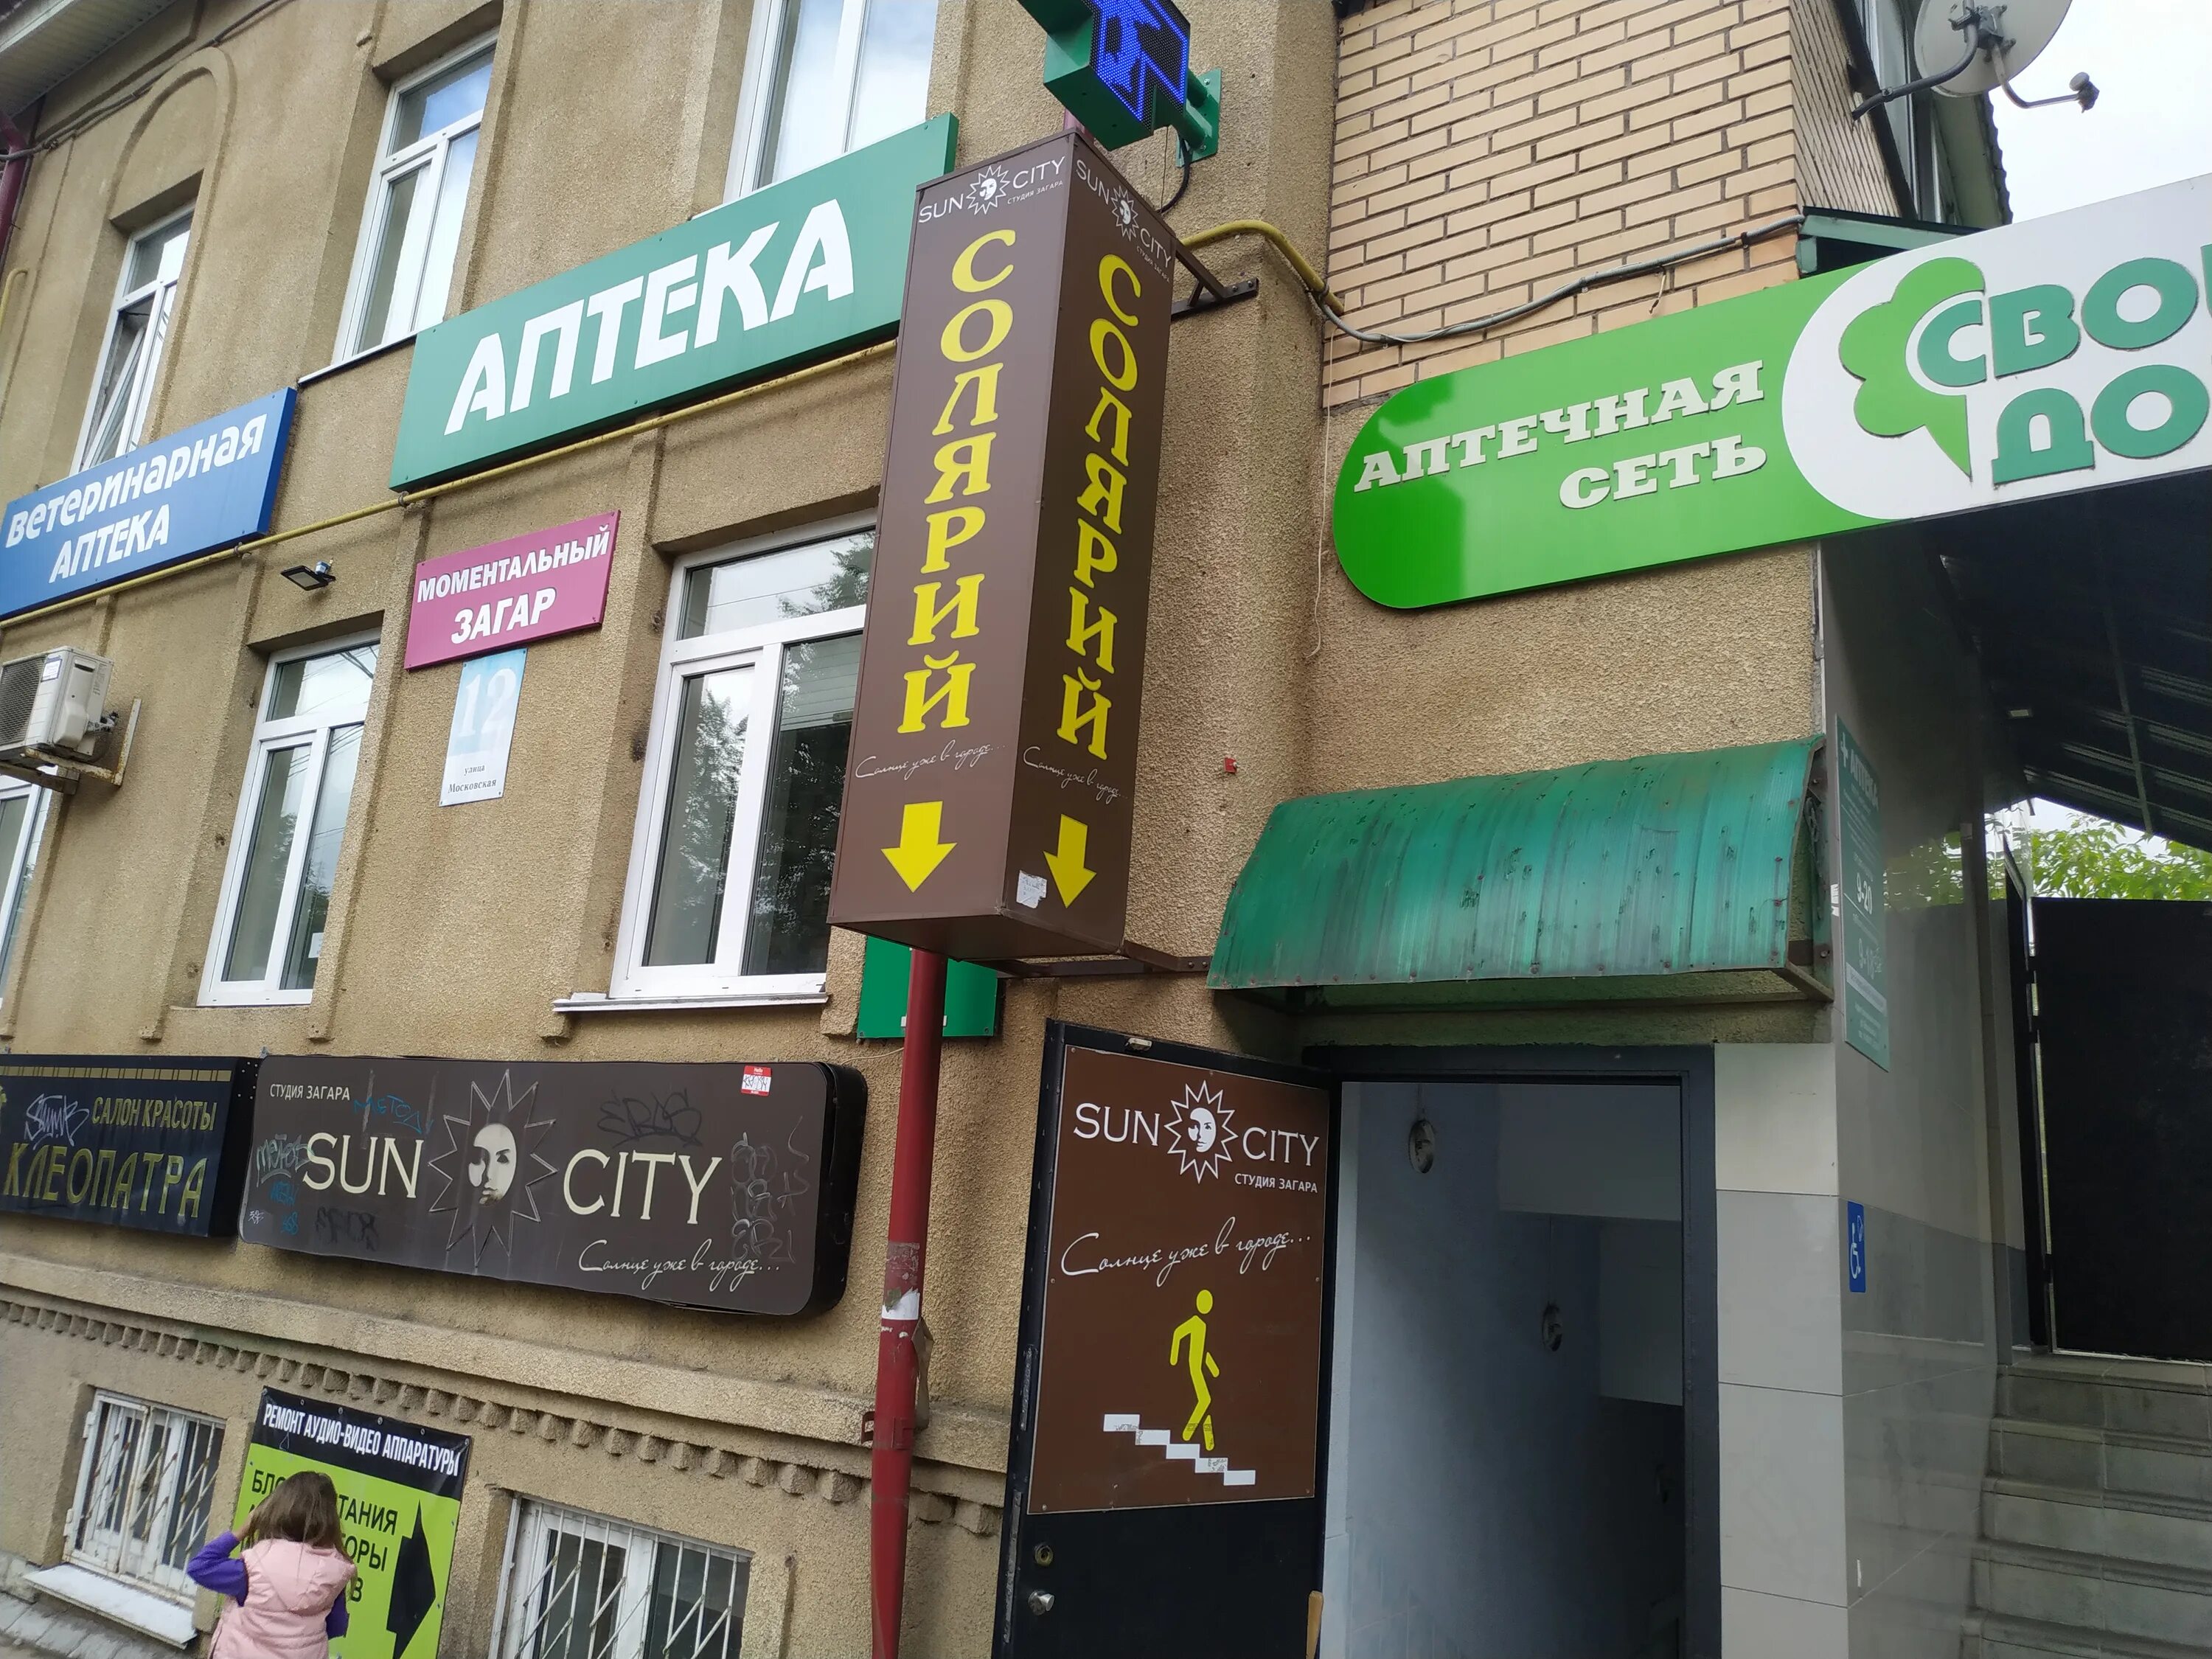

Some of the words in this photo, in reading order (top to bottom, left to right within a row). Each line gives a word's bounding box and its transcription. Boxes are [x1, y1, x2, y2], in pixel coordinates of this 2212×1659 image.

[919, 193, 964, 223] SUN
[1012, 156, 1066, 189] CITY
[1007, 190, 1034, 205] СТУДИЯ
[1036, 180, 1064, 195] ЗАГАРА
[1076, 159, 1110, 205] SUN
[1140, 228, 1172, 268] CITY
[444, 198, 854, 436] АПТЕКА
[1917, 243, 2212, 387] СВО
[1354, 360, 1764, 493] АПТЕЧНАЯ
[1992, 364, 2211, 486] ДО
[897, 229, 1016, 734] СОЛЯРИЙ
[1559, 434, 1767, 509] СЕТЬ
[1057, 254, 1141, 760] СОЛЯРИЙ
[48, 504, 170, 584] АПТЕКА
[417, 524, 611, 603] МОМЕНТАЛЬНЫЙ
[451, 588, 557, 644] ЗАГАР
[458, 667, 516, 737] 12
[448, 779, 497, 793] Московская
[464, 764, 485, 776] улица
[855, 756, 909, 778] Солнце
[904, 755, 937, 780] уже
[1023, 746, 1065, 776] Солнце
[1856, 872, 1873, 915] 9-20
[91, 1096, 142, 1127] САЛОН
[142, 1098, 218, 1131] КРАСОТЫ
[270, 1083, 303, 1100] СТУДИЯ
[306, 1085, 350, 1101] ЗАГАРА
[1073, 1102, 1161, 1147] SUN
[1242, 1127, 1321, 1166] CITY
[3, 1142, 208, 1218] КЛЕОПАТРА
[302, 1132, 425, 1199] SUN
[563, 1148, 723, 1225] CITY
[1234, 1172, 1276, 1189] СТУДИЯ
[1279, 1178, 1318, 1194] ЗАГАРА
[578, 1239, 650, 1275] Солнце
[641, 1259, 686, 1290] уже
[690, 1238, 712, 1271] в
[1060, 1232, 1163, 1276] Солнце
[1156, 1242, 1209, 1287] уже
[1214, 1217, 1236, 1254] в
[263, 1403, 305, 1436] РЕМОНТ
[303, 1414, 381, 1455] АУДИО-ВИДЕО
[382, 1434, 462, 1477] АППАРАТУРЫ
[338, 1494, 397, 1536] ТАНИЯ
